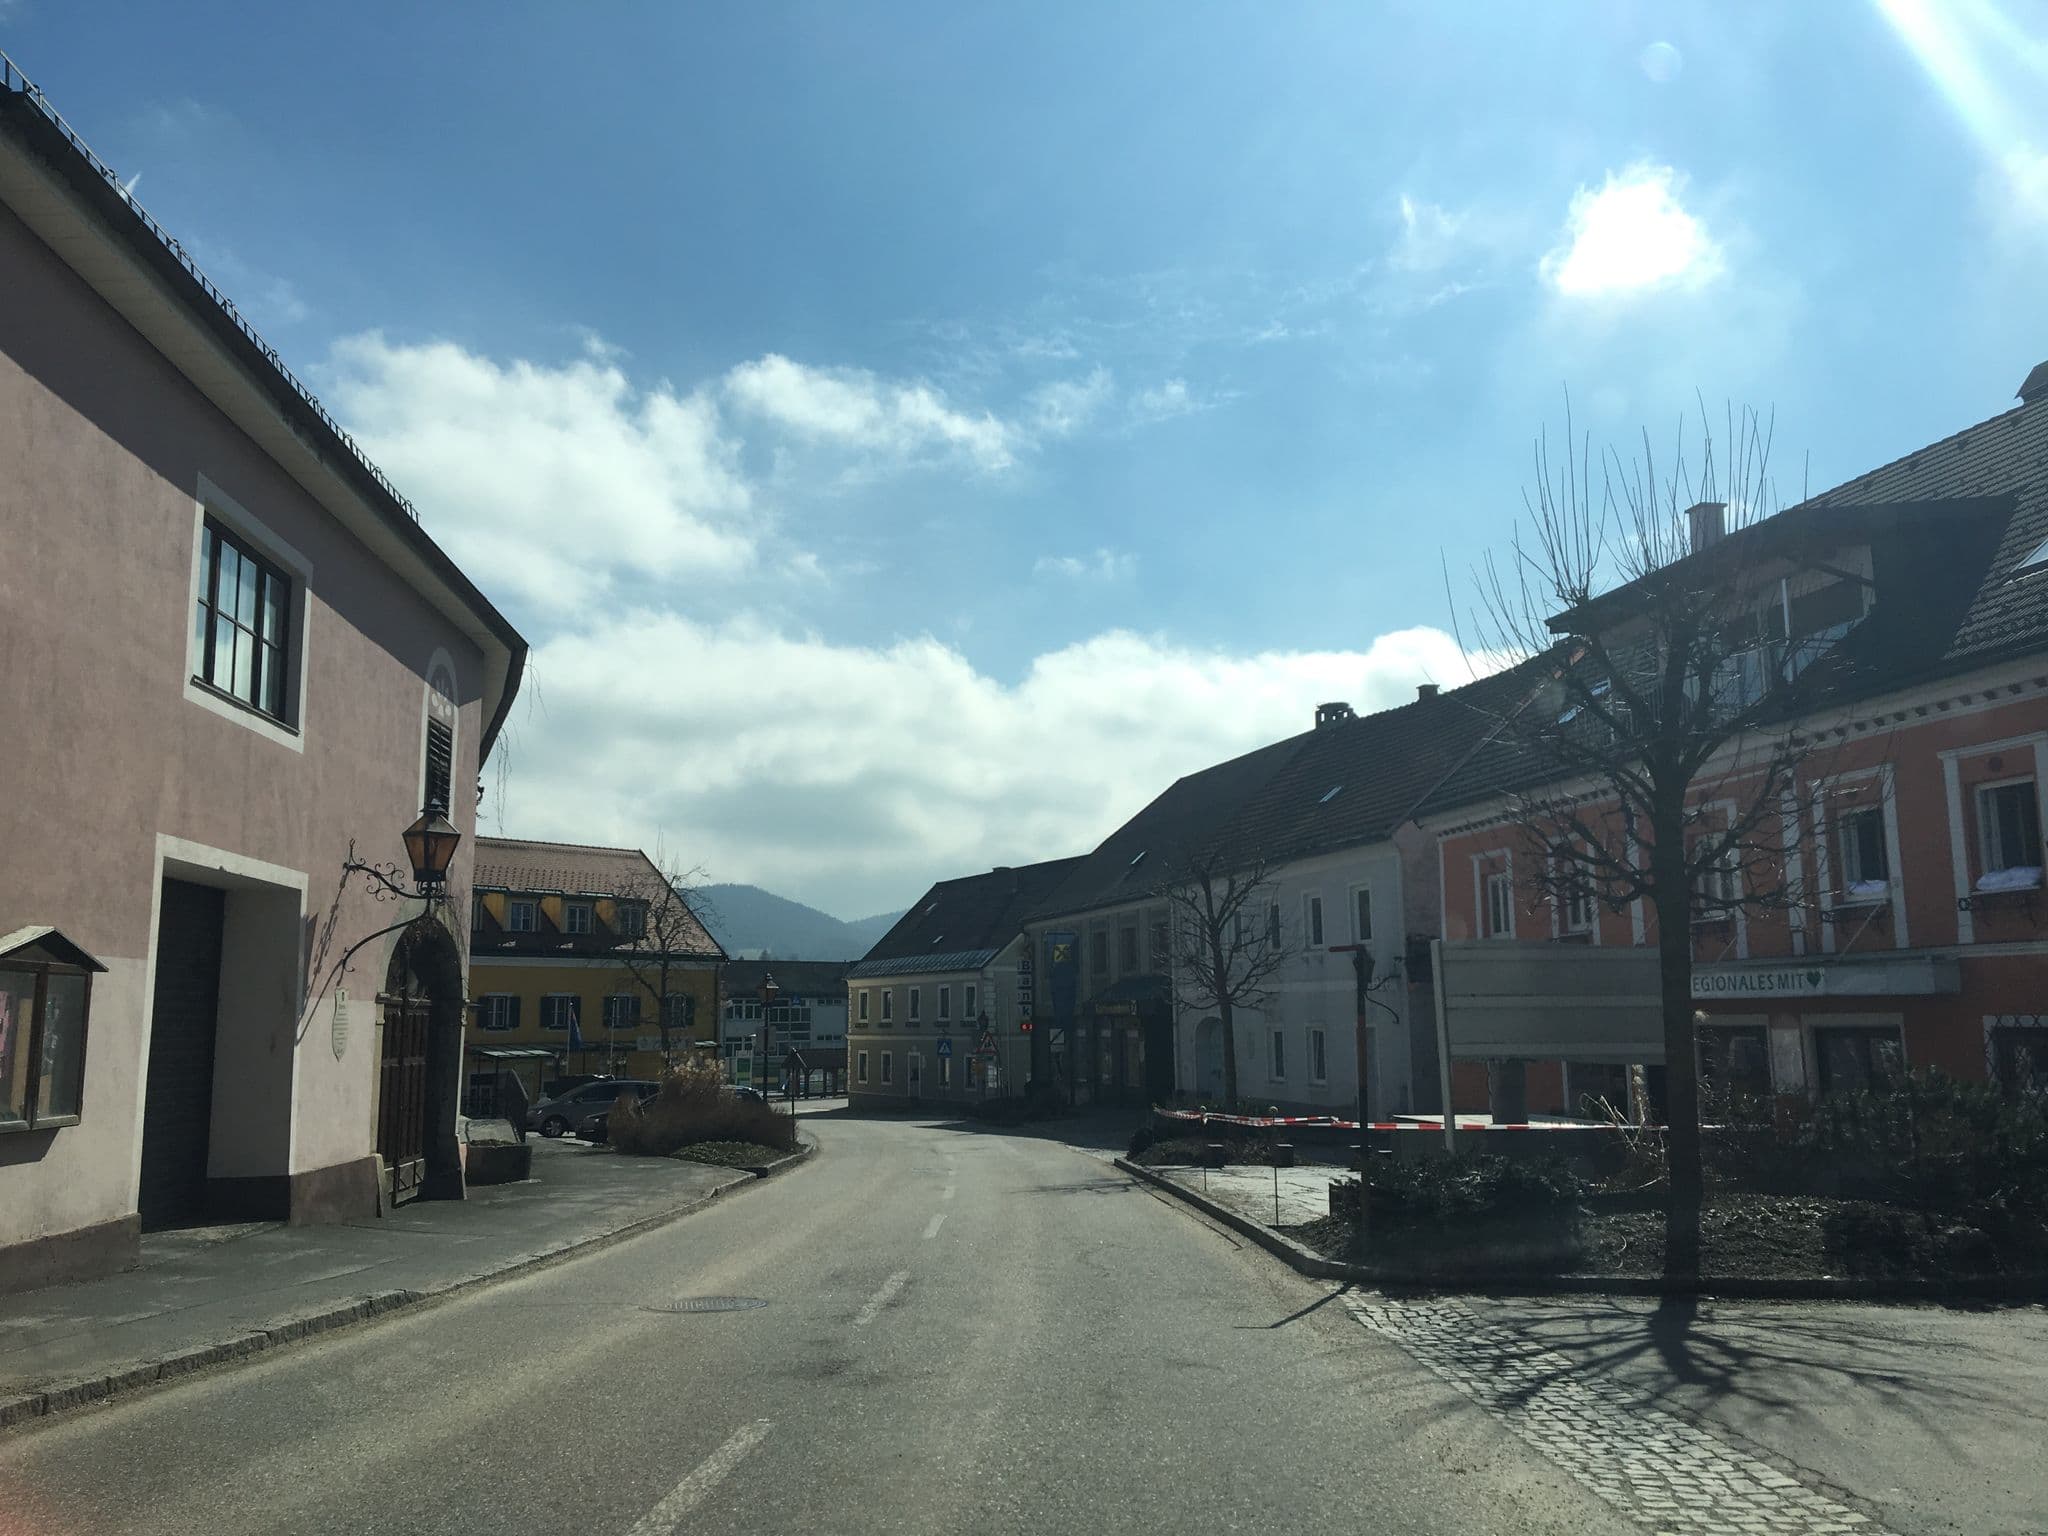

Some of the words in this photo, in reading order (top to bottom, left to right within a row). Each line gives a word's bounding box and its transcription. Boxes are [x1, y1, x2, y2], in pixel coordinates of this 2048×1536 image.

[1021, 960, 1032, 1017] Bank
[1692, 973, 1774, 993] EGIONALES
[1777, 973, 1805, 990] MIT
